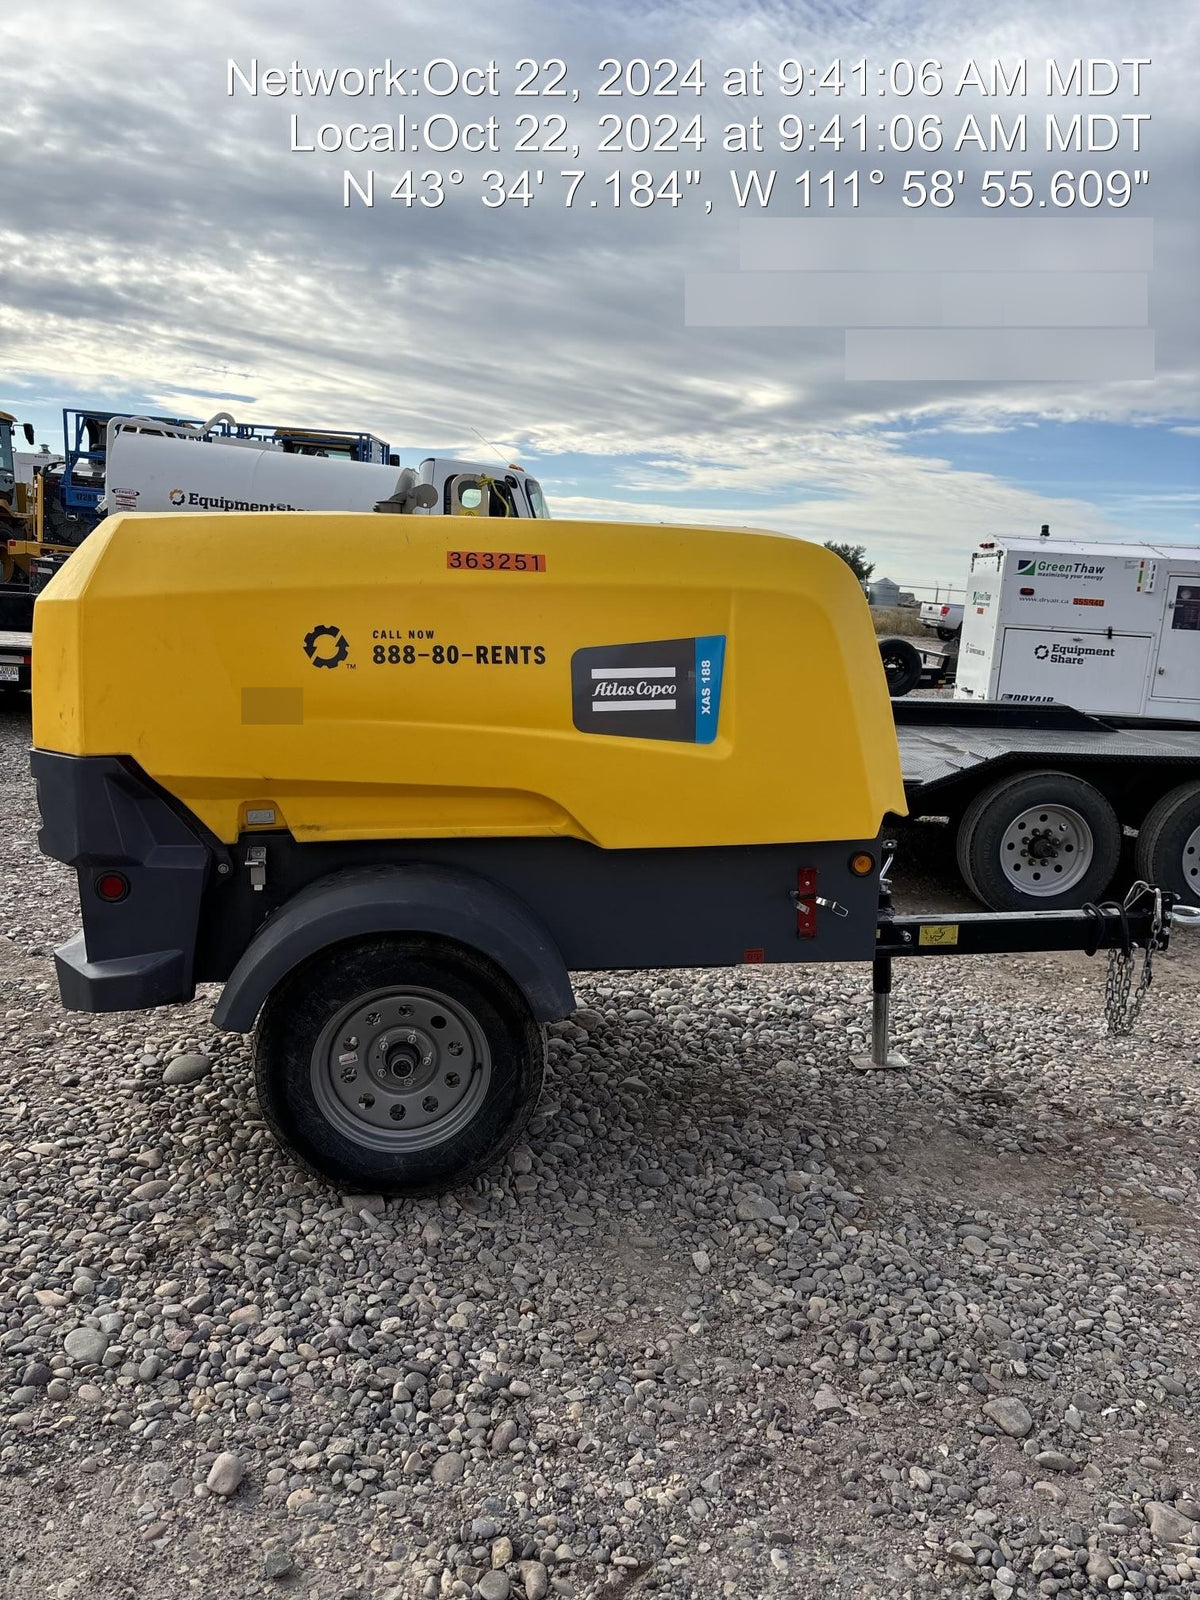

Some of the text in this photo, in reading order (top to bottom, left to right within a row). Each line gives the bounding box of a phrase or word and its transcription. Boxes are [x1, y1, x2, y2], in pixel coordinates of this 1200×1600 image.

[449, 552, 541, 571] 363251
[1037, 561, 1105, 575] GreenThaw
[1037, 572, 1069, 580] maximizing
[372, 630, 435, 640] CALL NOW
[372, 645, 547, 665] 888-80-RENTS
[1051, 643, 1116, 657] Equipment
[1050, 654, 1085, 665] Share
[701, 659, 712, 715] XAS 188
